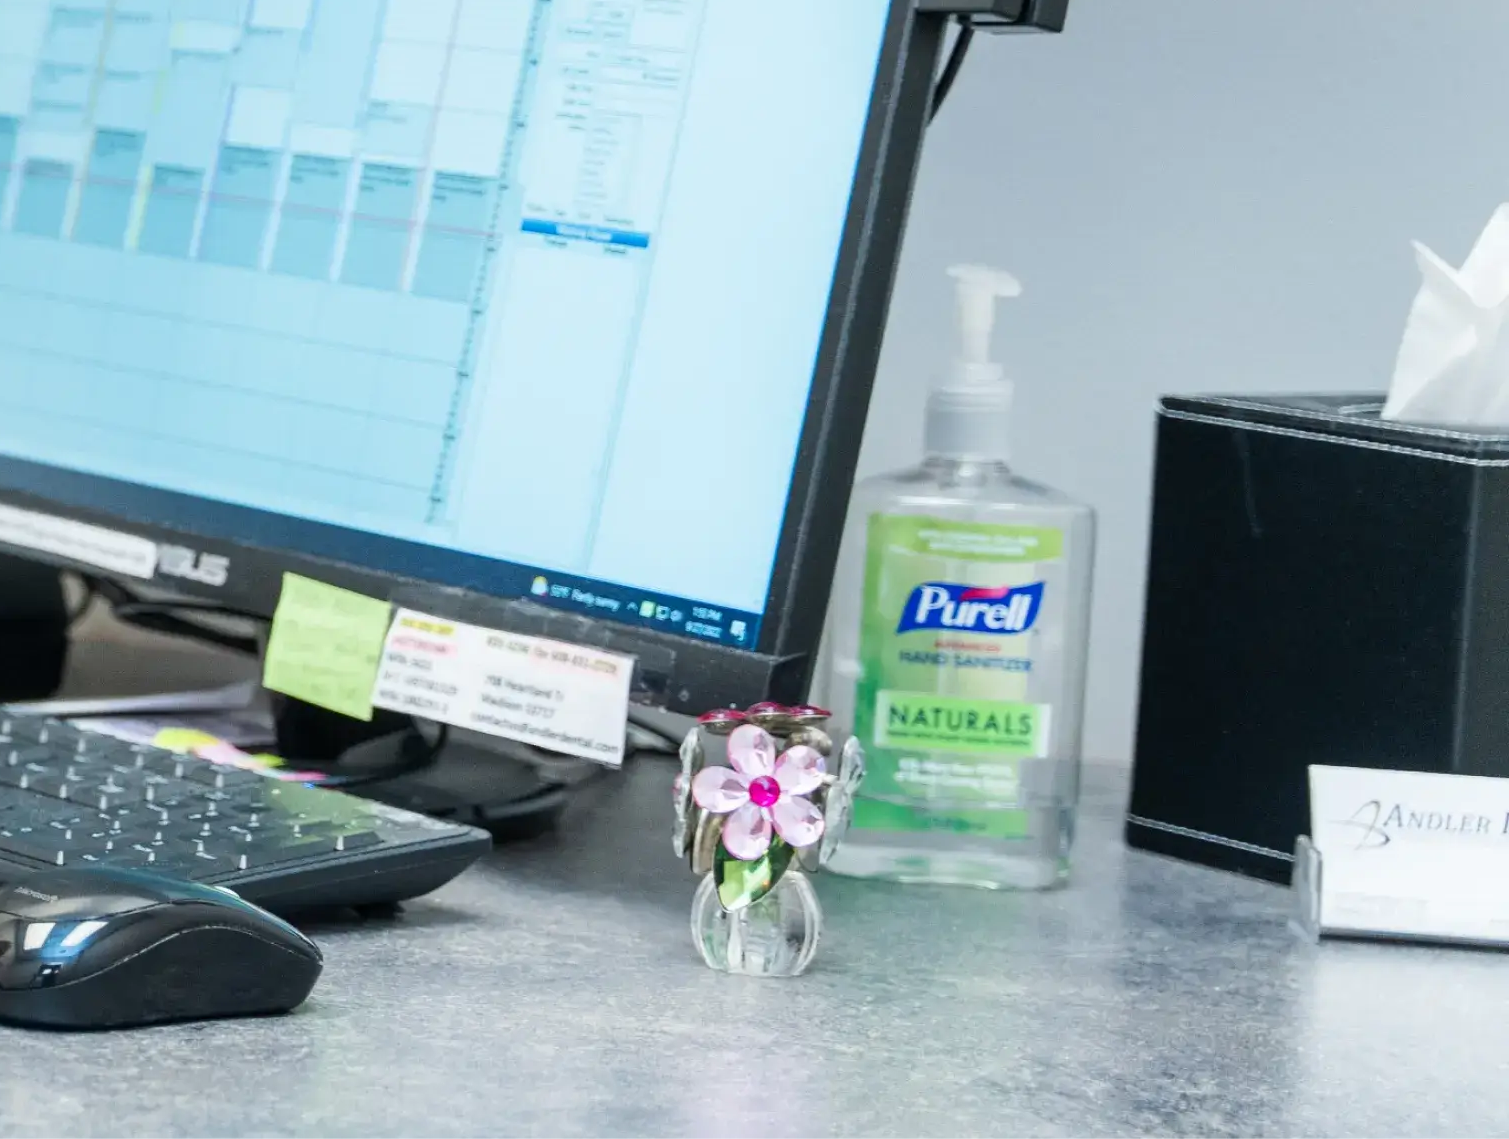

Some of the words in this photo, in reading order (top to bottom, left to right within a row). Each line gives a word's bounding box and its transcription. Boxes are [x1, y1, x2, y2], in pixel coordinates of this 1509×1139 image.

[914, 584, 1033, 632] Purell
[889, 704, 1033, 736] NATURALS
[1383, 803, 1492, 836] ANDLER
